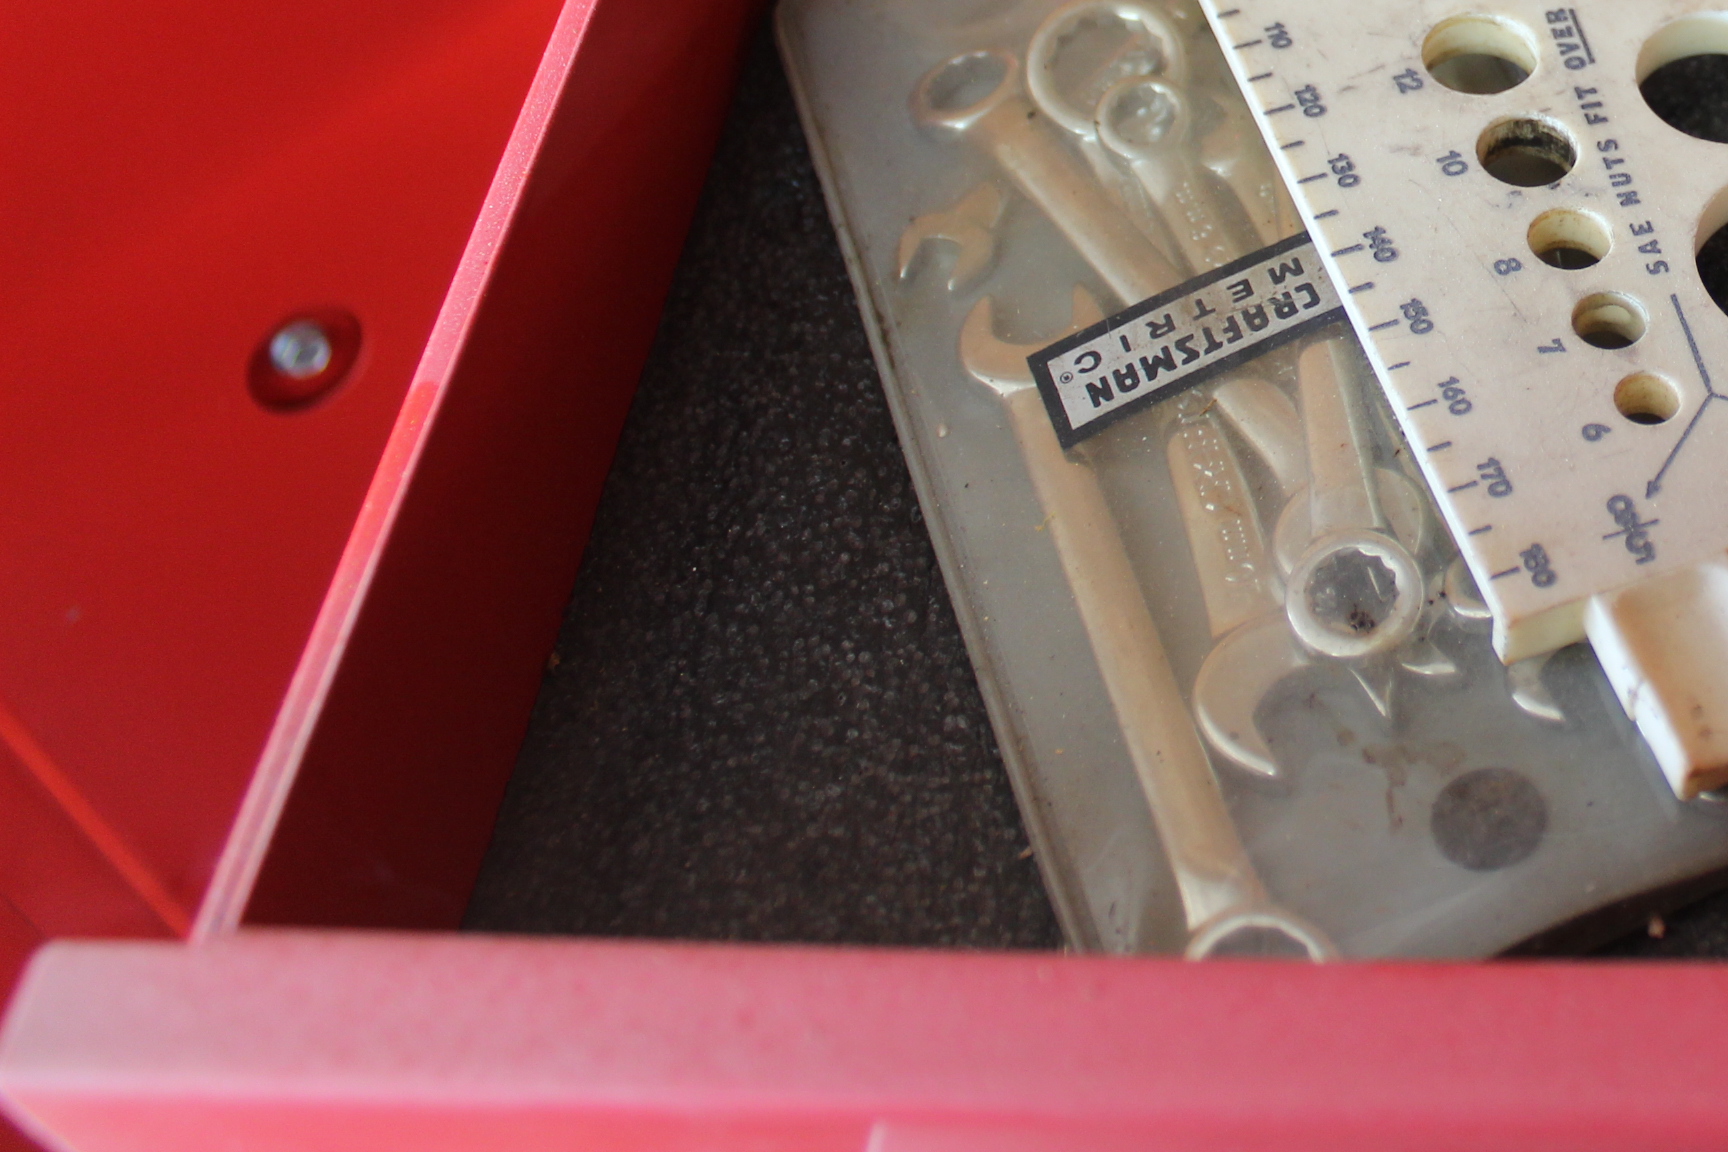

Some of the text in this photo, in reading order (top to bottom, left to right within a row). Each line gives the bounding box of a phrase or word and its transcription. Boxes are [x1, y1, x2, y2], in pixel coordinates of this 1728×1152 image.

[1264, 22, 1293, 49] 110
[1543, 8, 1588, 71] OVER
[1392, 68, 1423, 94] 12
[1294, 84, 1327, 118] 120
[1574, 87, 1608, 126] FIT
[1327, 153, 1361, 188] 130
[1436, 150, 1468, 176] 10
[1597, 139, 1641, 207] NUTS
[1363, 226, 1399, 262] 140
[1629, 221, 1669, 275] SAE
[1494, 258, 1523, 276] 8
[1074, 257, 1305, 375] METRIC
[1400, 298, 1434, 334] 150
[1085, 281, 1322, 409] CRAFTSMAN
[1537, 338, 1566, 354] 7
[1437, 376, 1472, 416] 160
[1582, 423, 1611, 442] 6
[1477, 457, 1513, 498] 170
[1602, 494, 1659, 565] 5/8
[1519, 543, 1557, 588] 180
